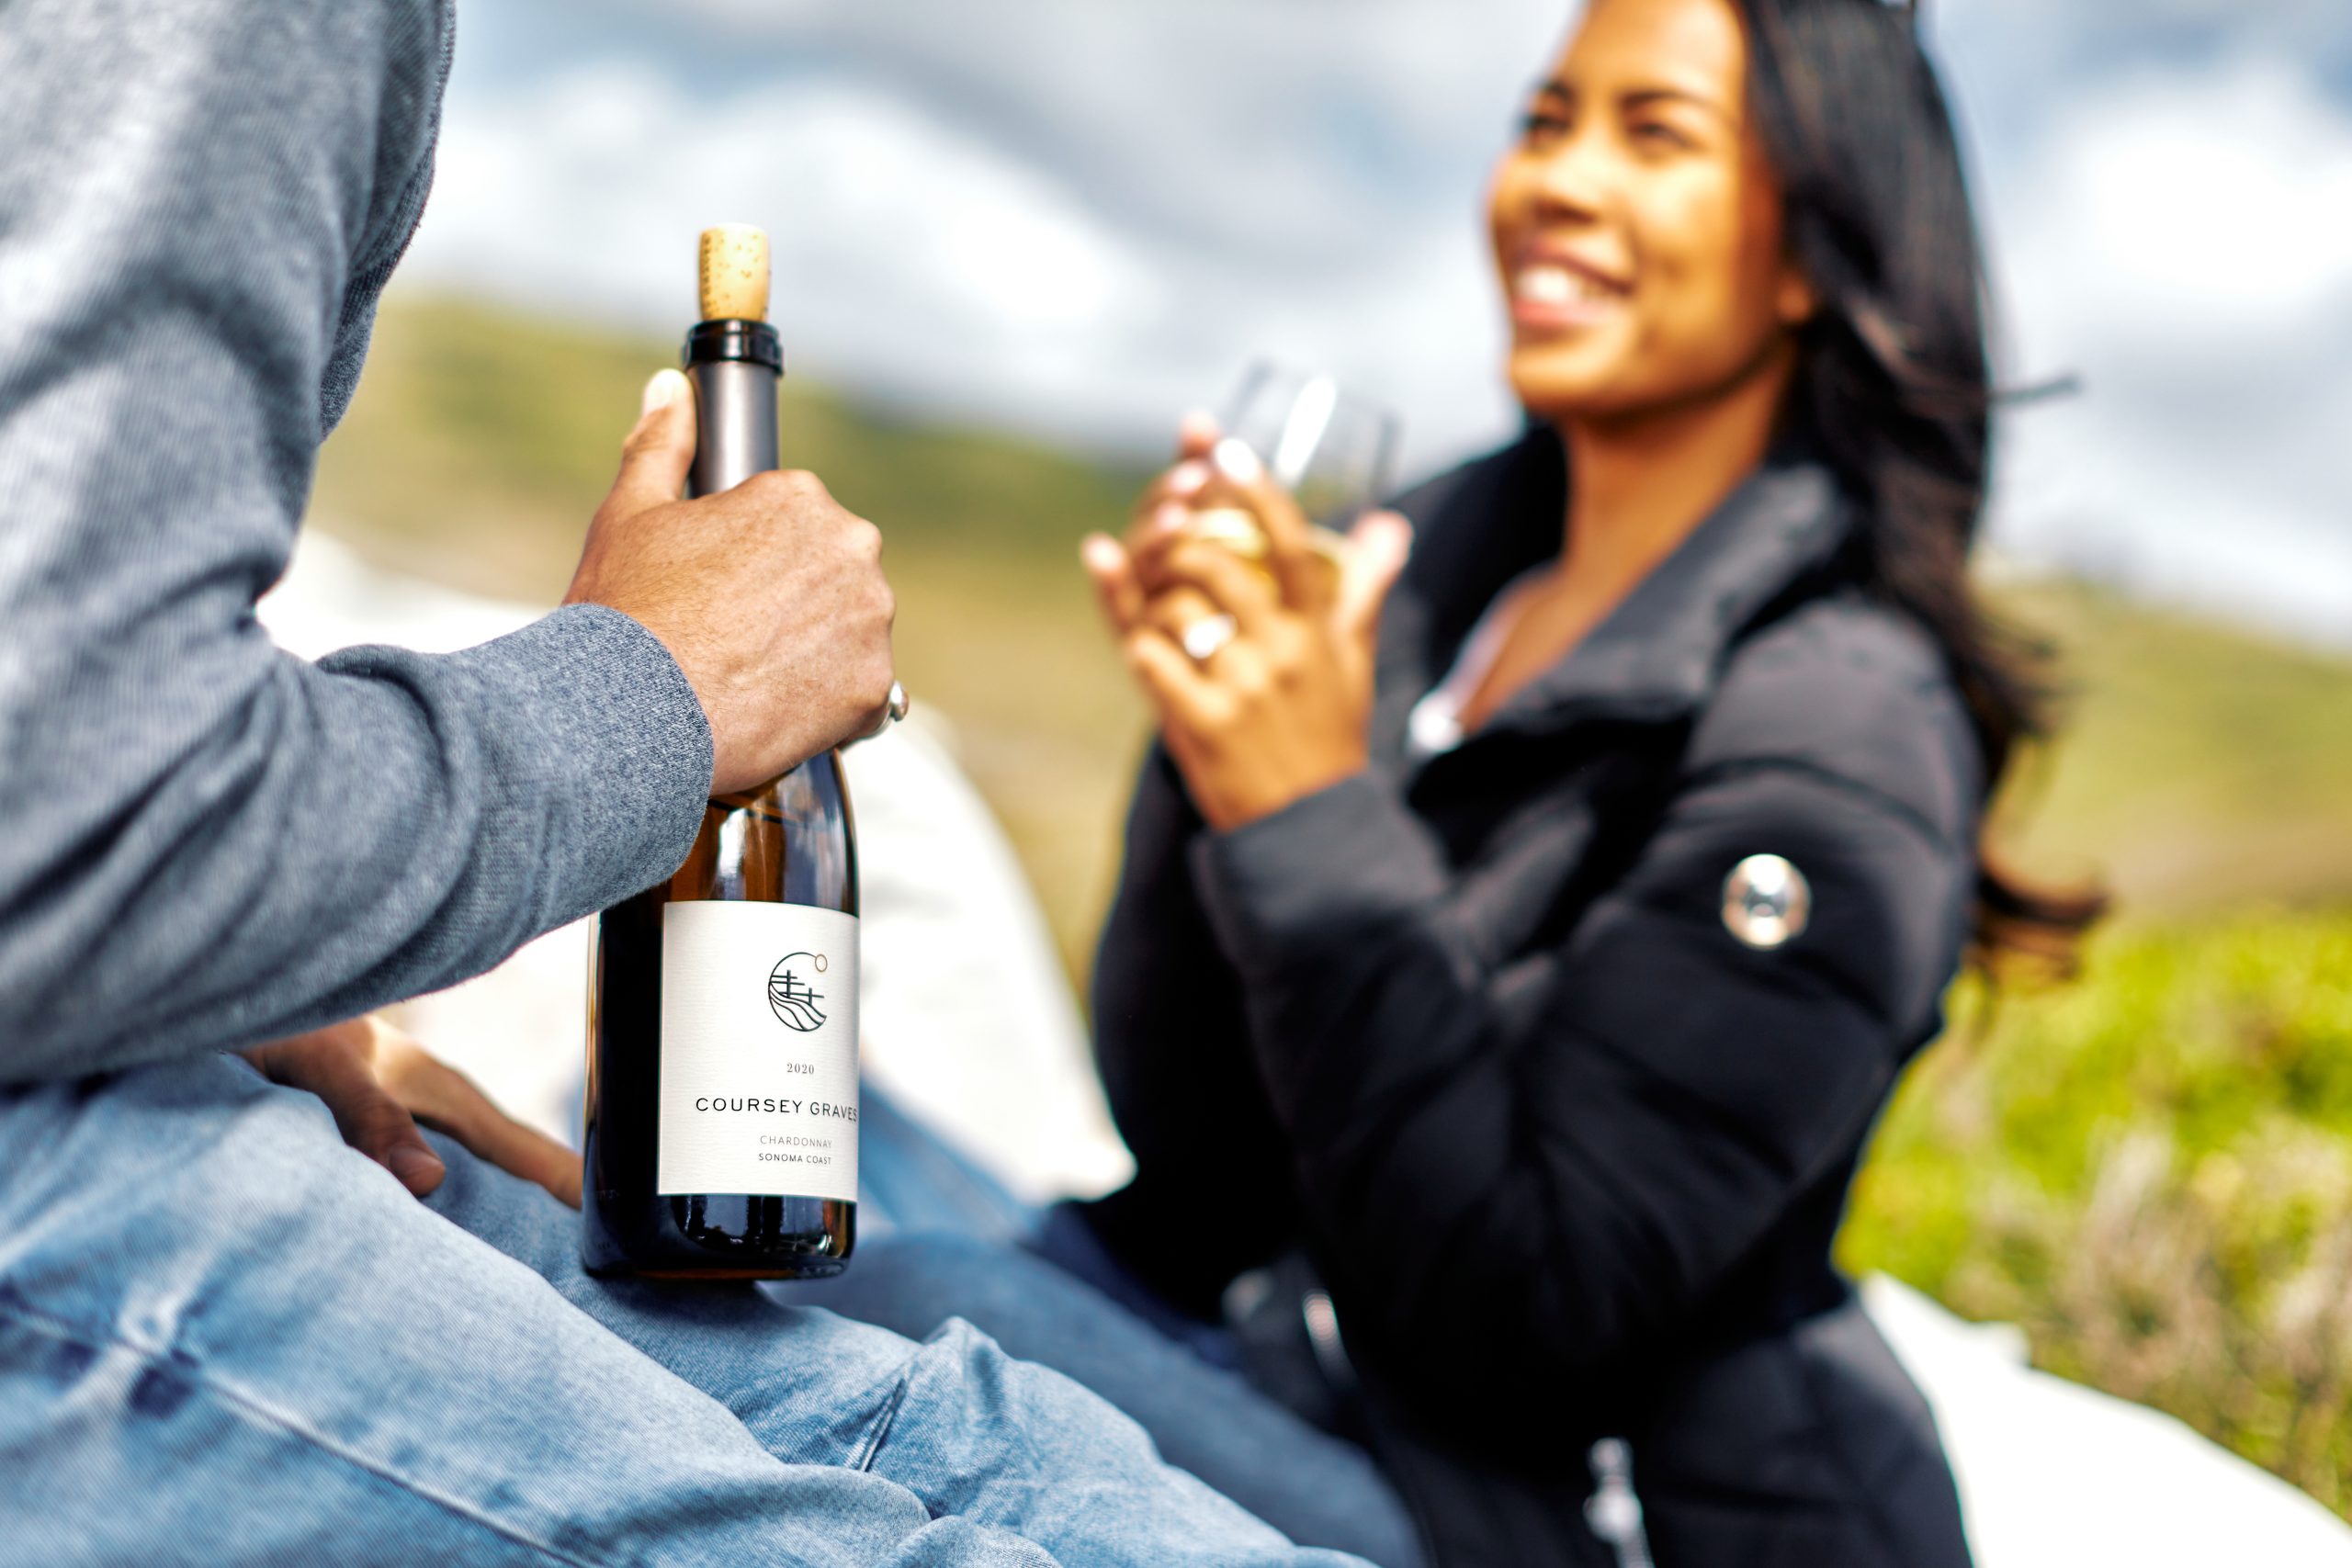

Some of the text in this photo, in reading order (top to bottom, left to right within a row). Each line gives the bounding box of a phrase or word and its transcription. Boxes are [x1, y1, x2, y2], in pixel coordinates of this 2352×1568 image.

[786, 1063, 815, 1075] 2020
[695, 1098, 857, 1122] COURSEY GRAVES
[760, 1134, 832, 1148] CHARDONNAY
[758, 1153, 831, 1165] SONOMA COAST
